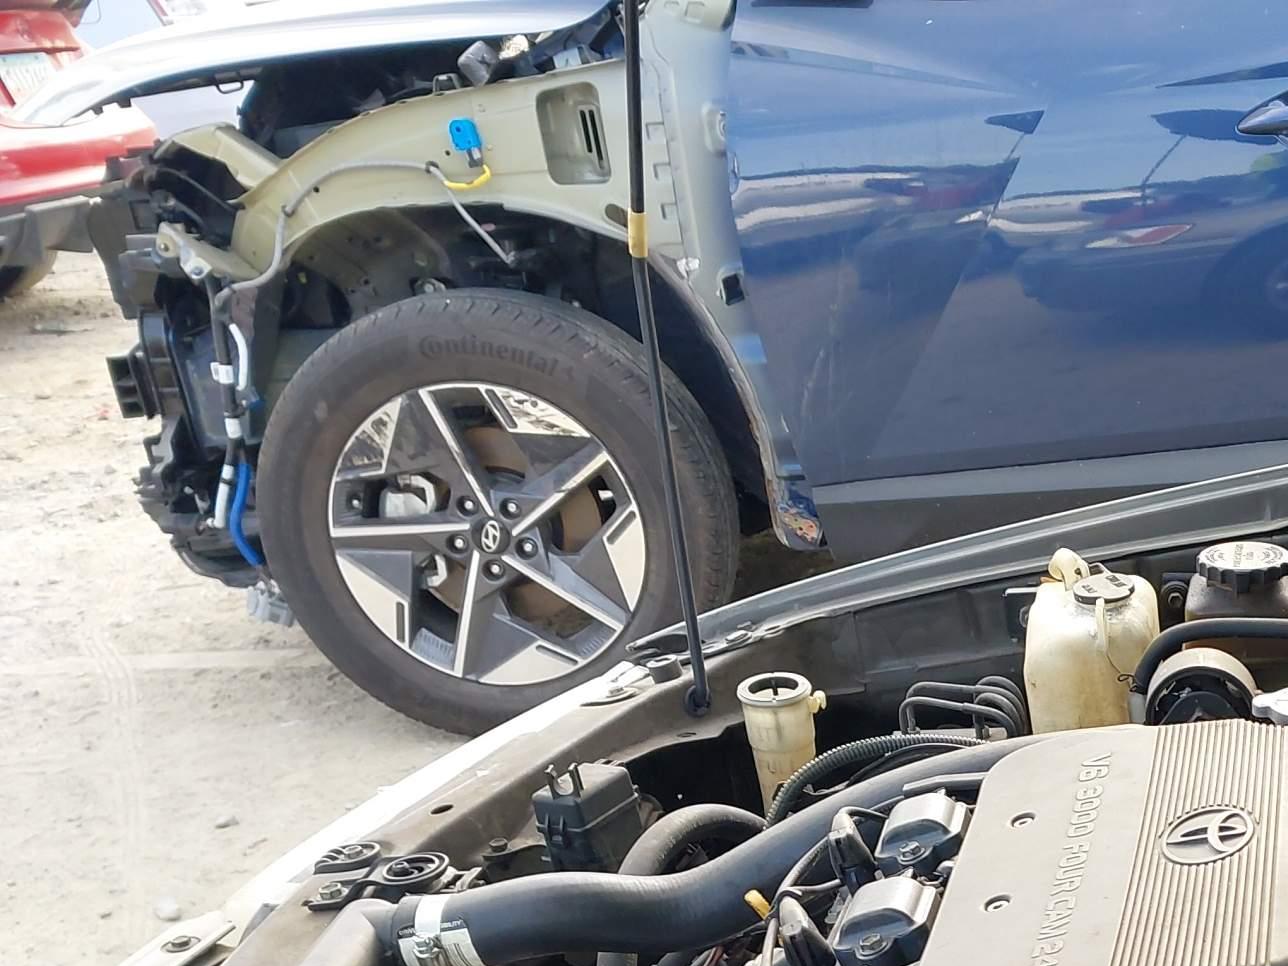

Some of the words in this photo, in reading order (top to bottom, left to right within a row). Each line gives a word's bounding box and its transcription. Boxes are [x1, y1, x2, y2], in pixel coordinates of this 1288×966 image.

[418, 333, 559, 377] Continental
[1078, 752, 1112, 782] V6
[1067, 784, 1103, 838] 3000
[1050, 841, 1089, 896] FOUR
[1037, 896, 1076, 940] CAM
